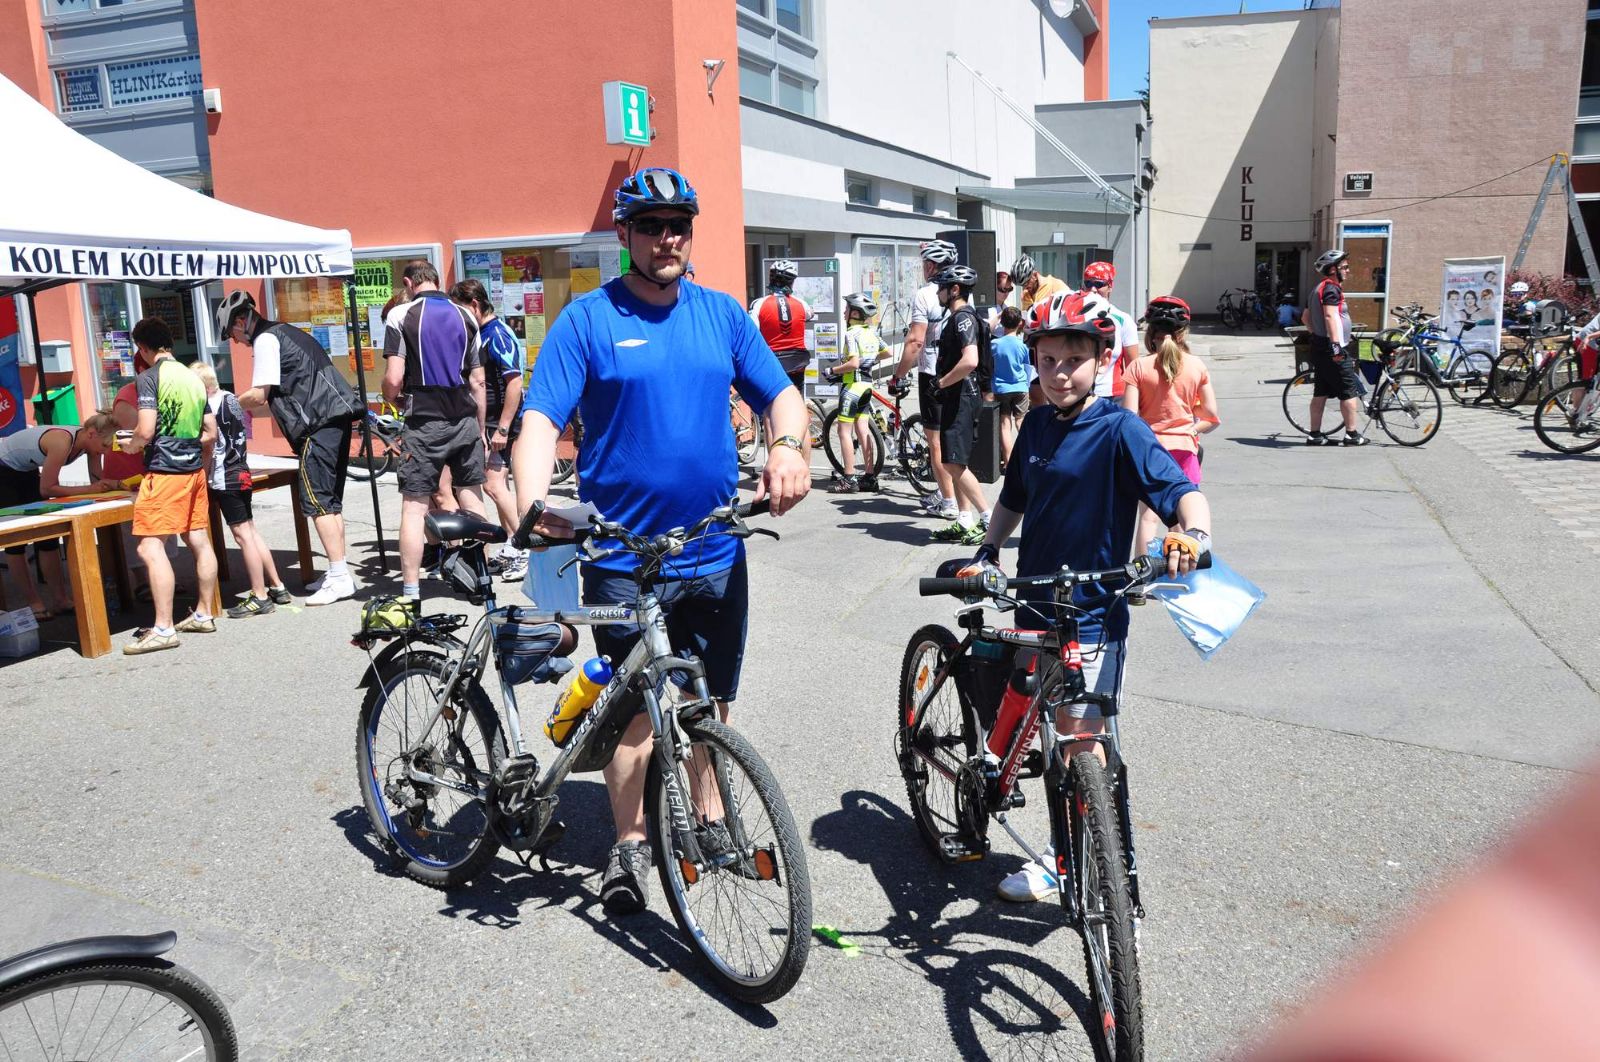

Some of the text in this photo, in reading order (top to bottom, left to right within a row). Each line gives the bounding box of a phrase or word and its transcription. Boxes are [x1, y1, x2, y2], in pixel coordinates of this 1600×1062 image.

[1240, 166, 1255, 242] KLUB
[9, 246, 330, 276] KOLEM KOLEM HUMPOLCE
[354, 267, 388, 276] ICHAL
[355, 275, 389, 287] AVID
[589, 609, 626, 619] GENESIS
[1005, 711, 1041, 786] SPRINTE
